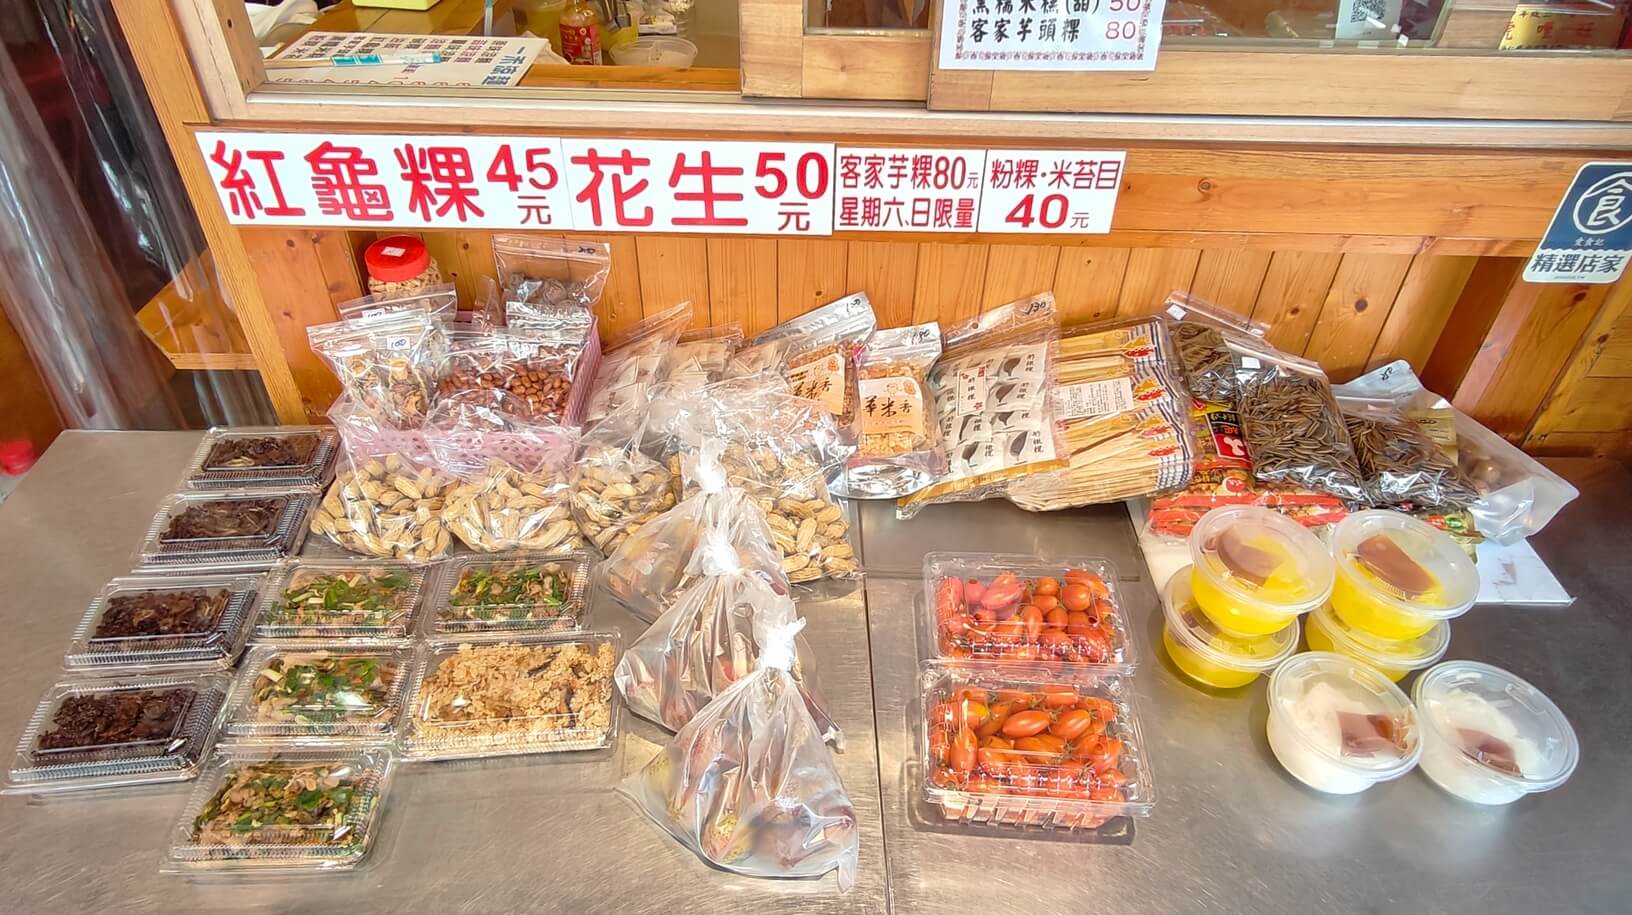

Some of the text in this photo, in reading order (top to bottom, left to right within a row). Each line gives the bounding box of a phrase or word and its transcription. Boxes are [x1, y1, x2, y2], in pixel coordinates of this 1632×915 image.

[969, 17, 1136, 43] 客家芋頭粿 80
[210, 140, 559, 225] 紅龜粿 45 元
[570, 148, 829, 231] 花生 50 元
[1530, 253, 1625, 273] 精選店家
